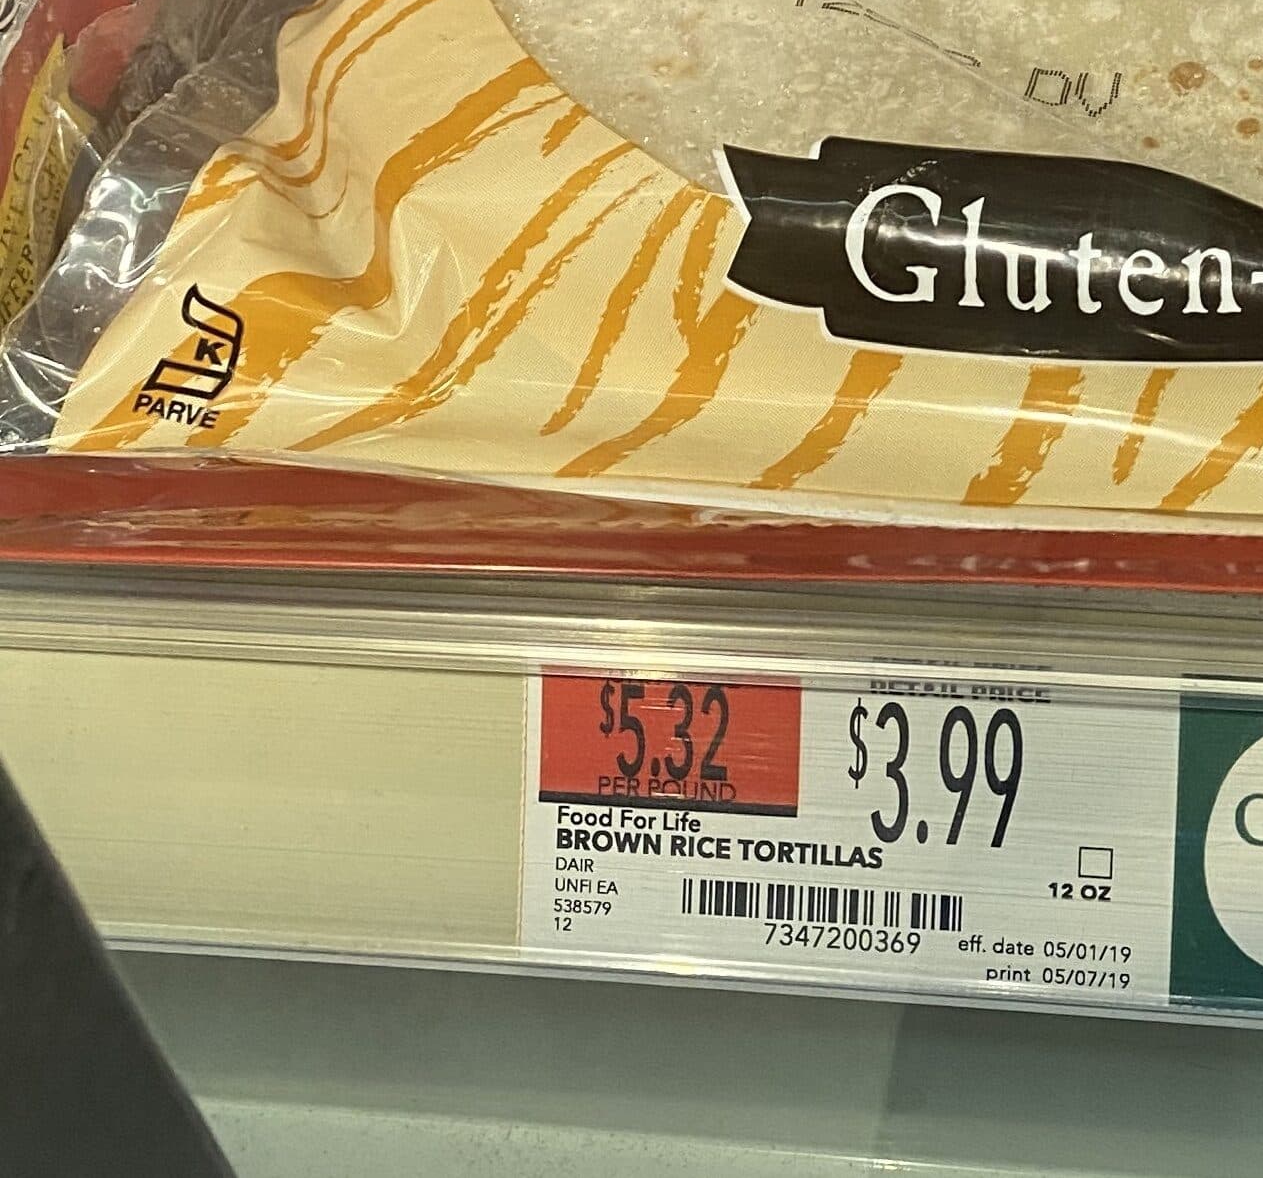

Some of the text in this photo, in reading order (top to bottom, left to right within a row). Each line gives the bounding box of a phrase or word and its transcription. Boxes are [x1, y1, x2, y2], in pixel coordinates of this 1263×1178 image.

[133, 393, 221, 430] PARVE
[599, 679, 730, 782] $5.32
[848, 697, 1024, 849] $3.99
[598, 776, 738, 804] PER POUND
[557, 806, 702, 834] Food For Life
[556, 828, 884, 869] BROWN RICE TORTILLAS
[554, 857, 595, 873] DAIR
[554, 879, 619, 896] UNFI EA
[1048, 882, 1112, 902] 12 OZ
[553, 898, 613, 916] 538579
[554, 917, 573, 932] 12
[763, 922, 922, 955] 7347200369
[958, 935, 1132, 964] eff. date 05/01/19
[986, 965, 1131, 990] print 05/07/19
